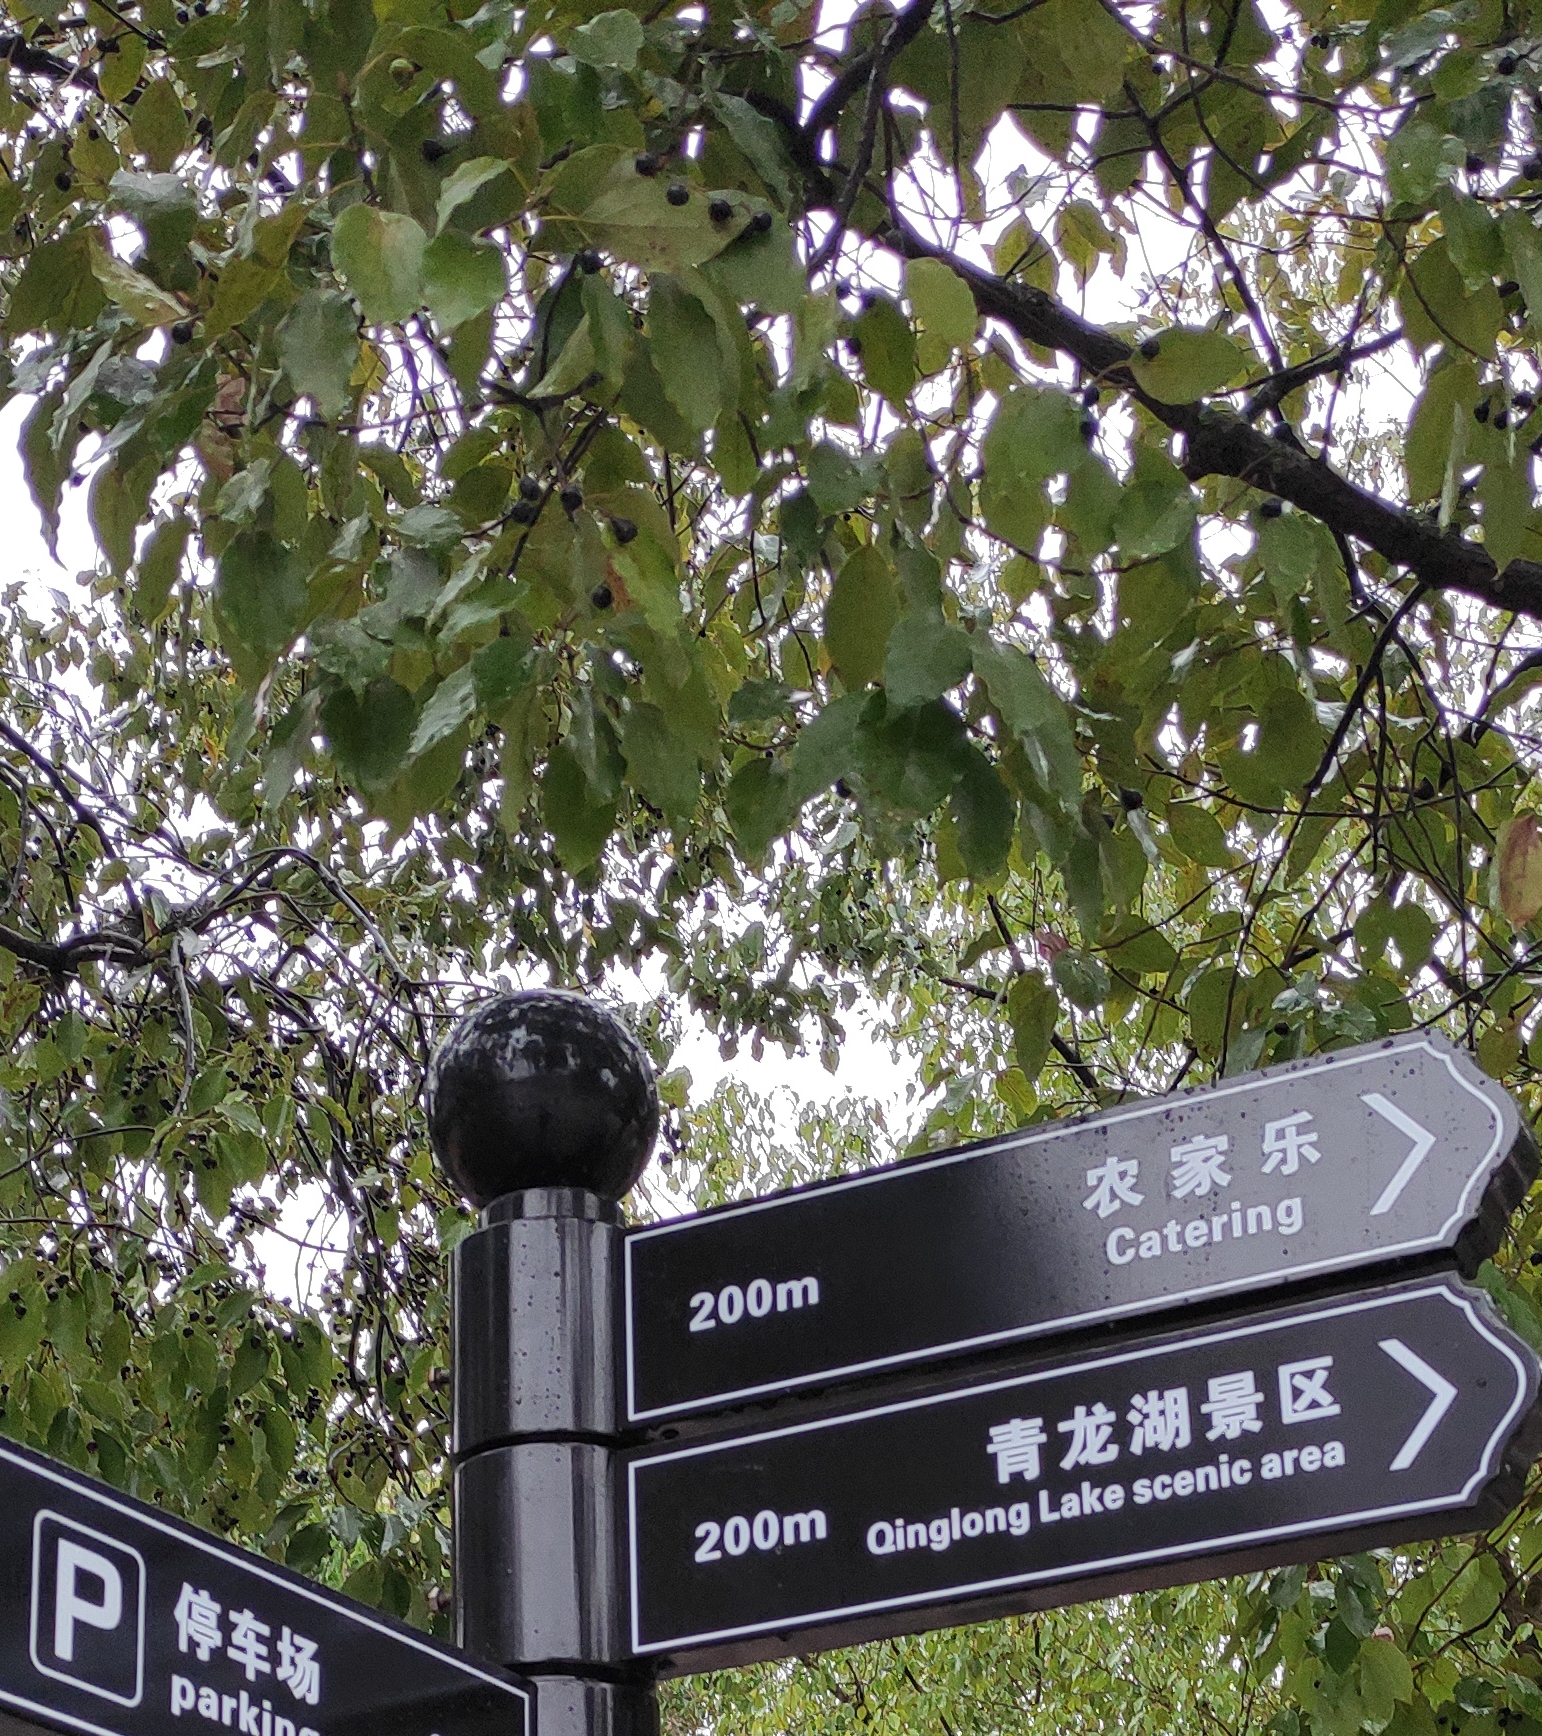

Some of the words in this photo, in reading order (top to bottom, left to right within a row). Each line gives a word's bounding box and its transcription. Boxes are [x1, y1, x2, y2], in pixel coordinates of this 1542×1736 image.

[1082, 1110, 1322, 1220] 农家乐
[1105, 1197, 1305, 1265] Catering
[688, 1275, 820, 1333] 200m
[986, 1355, 1342, 1485] 青龙湖景区
[693, 1508, 828, 1564] 200m
[866, 1501, 1031, 1555] Qinglong
[1038, 1480, 1126, 1523] Lake
[1132, 1454, 1253, 1505] scenic
[1260, 1440, 1347, 1481] area
[54, 1536, 123, 1662] P
[172, 1581, 320, 1706] 停车场
